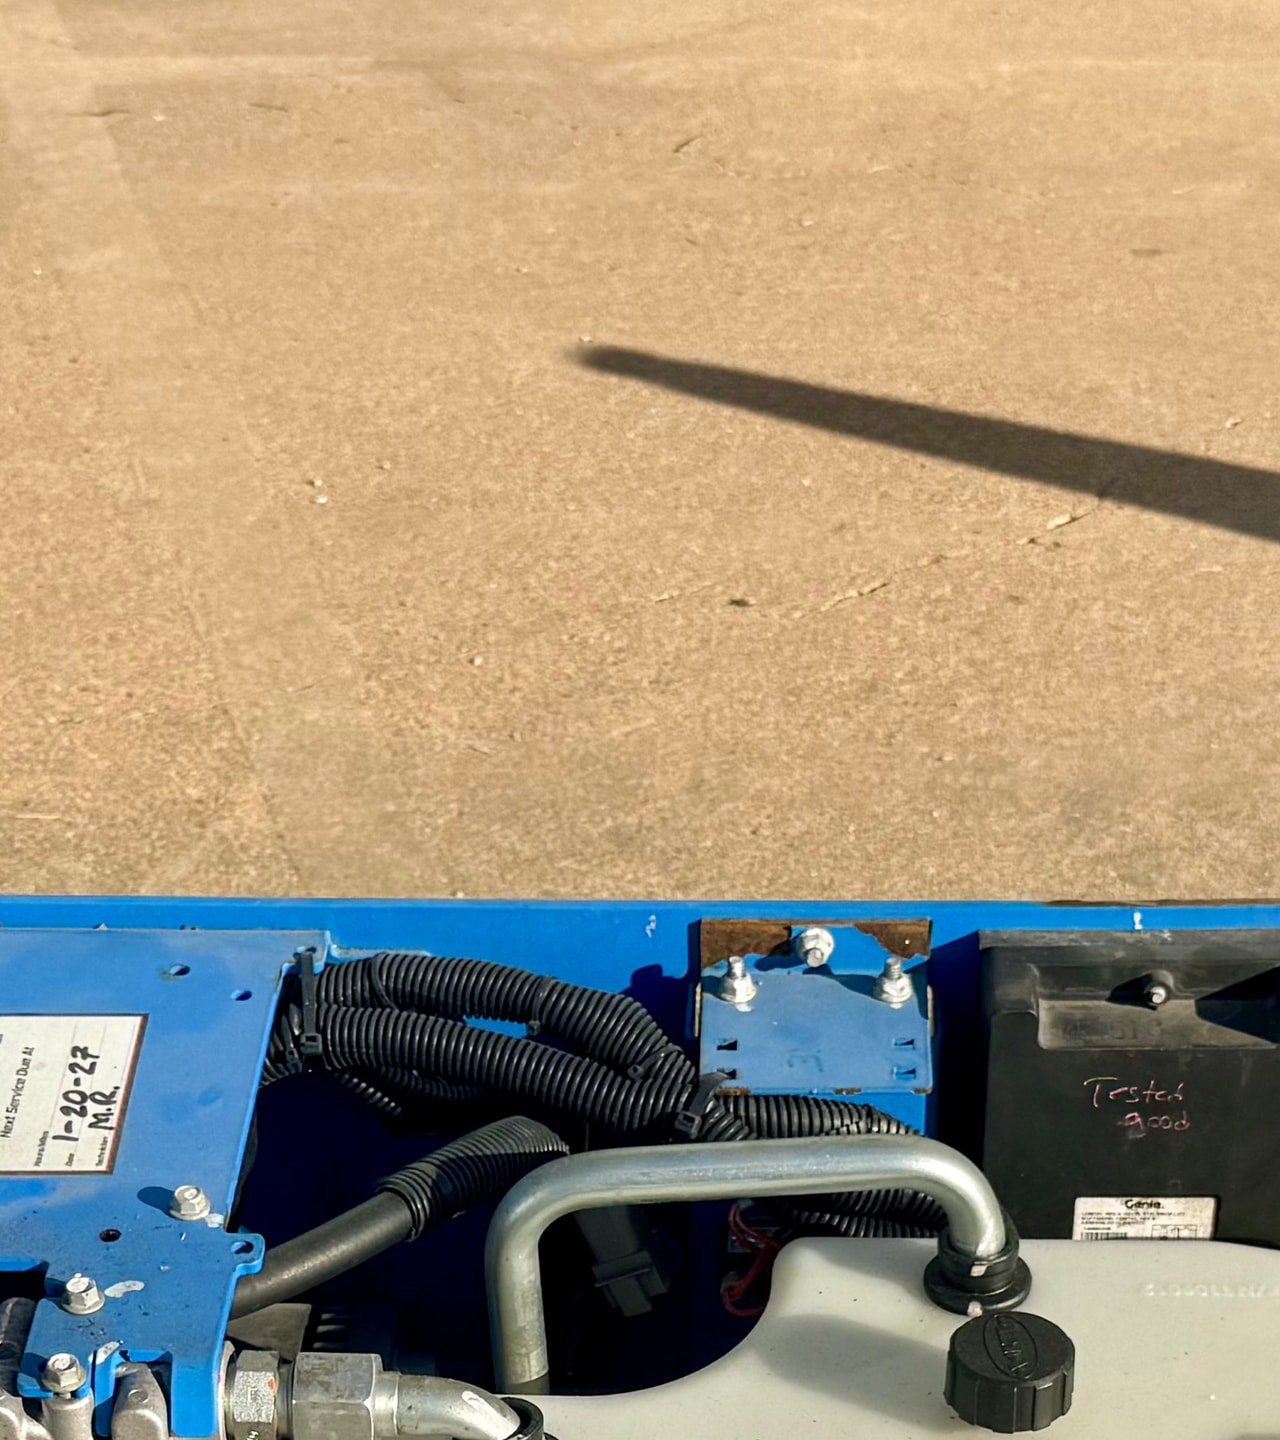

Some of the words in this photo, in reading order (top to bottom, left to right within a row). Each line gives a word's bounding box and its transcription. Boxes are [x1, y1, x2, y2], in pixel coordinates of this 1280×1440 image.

[16, 1058, 31, 1076] Due
[5, 1078, 26, 1114] Service
[1083, 1076, 1185, 1108] Tested
[0, 1116, 16, 1138] Next
[1119, 1110, 1191, 1139] good
